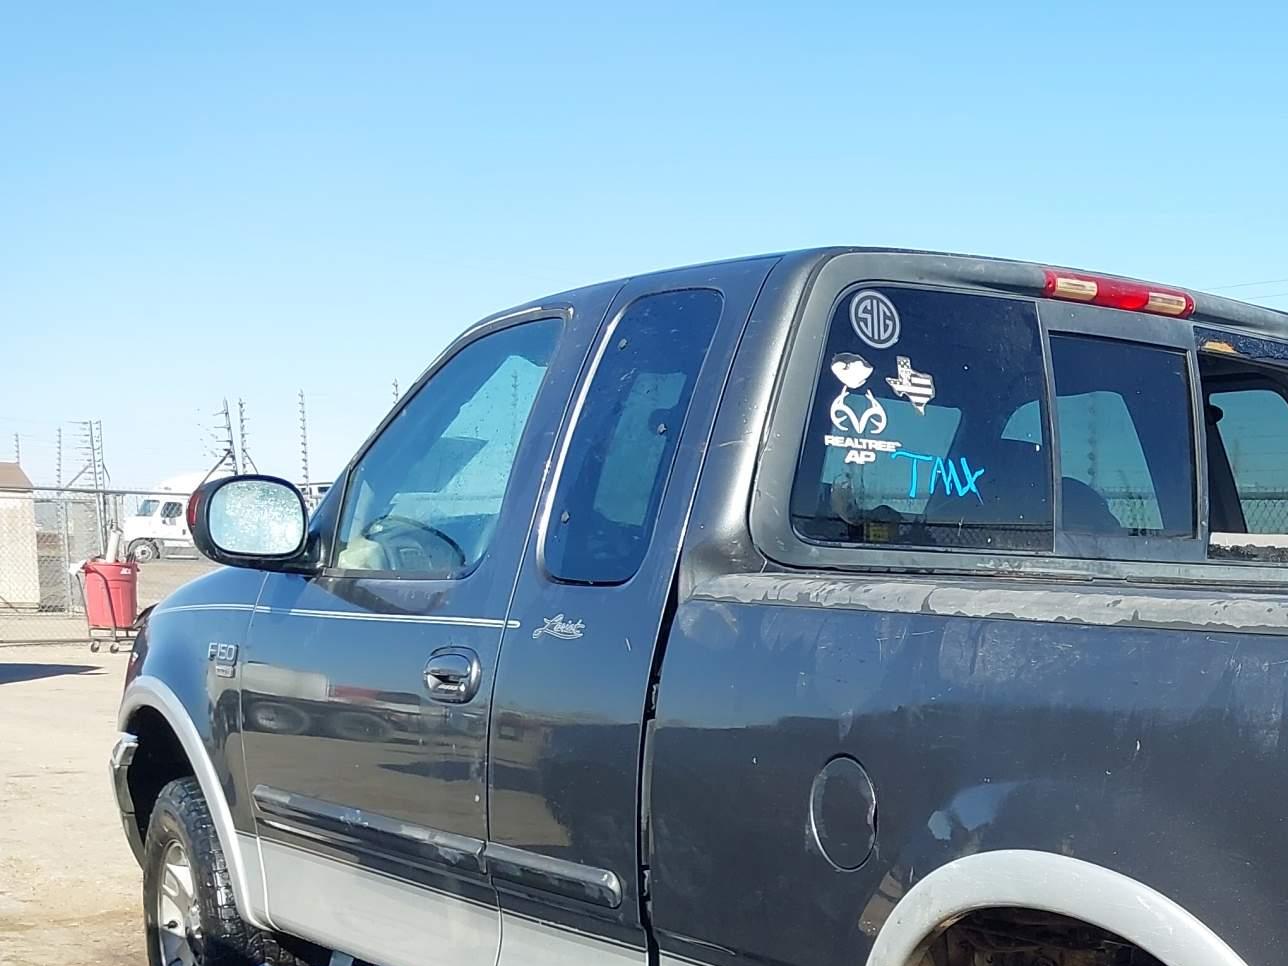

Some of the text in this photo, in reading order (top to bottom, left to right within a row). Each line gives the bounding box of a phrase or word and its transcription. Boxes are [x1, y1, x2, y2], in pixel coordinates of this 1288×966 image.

[858, 299, 893, 341] SIG
[824, 434, 902, 452] REALTREE
[844, 450, 876, 465] AP
